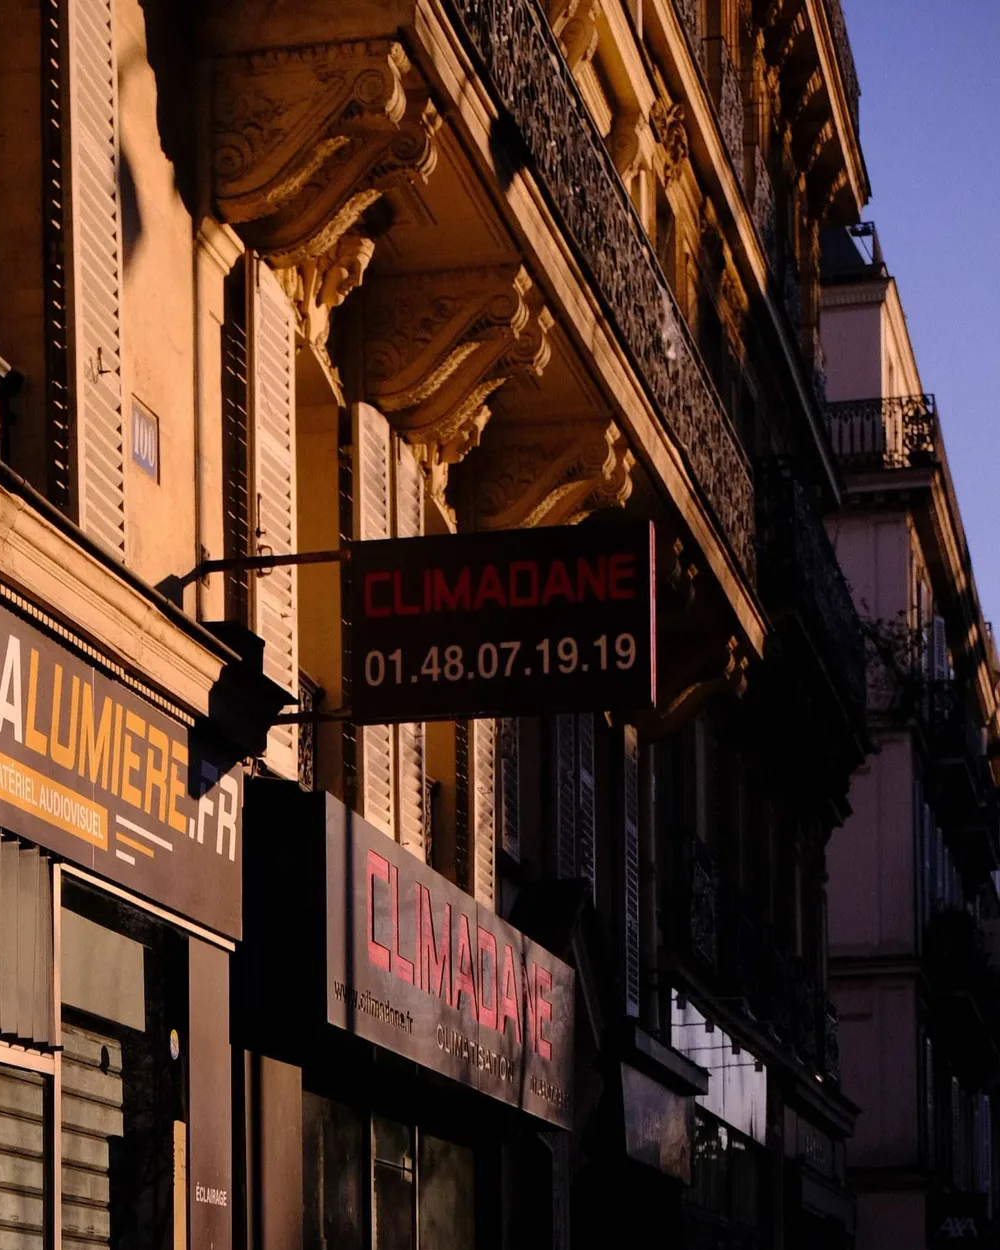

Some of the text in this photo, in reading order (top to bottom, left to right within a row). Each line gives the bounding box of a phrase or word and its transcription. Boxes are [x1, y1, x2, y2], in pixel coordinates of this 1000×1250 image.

[134, 411, 155, 468] 100
[364, 553, 635, 617] CLIMADANE
[364, 633, 636, 687] 01.48.07.19.19
[40, 784, 104, 839] AUDIOVISUEL
[367, 849, 552, 1061] CLIMADANE
[437, 1024, 514, 1084] CLIMATISATION
[196, 1182, 227, 1206] ÉCLAIRAGE
[935, 1215, 977, 1238] AXA
